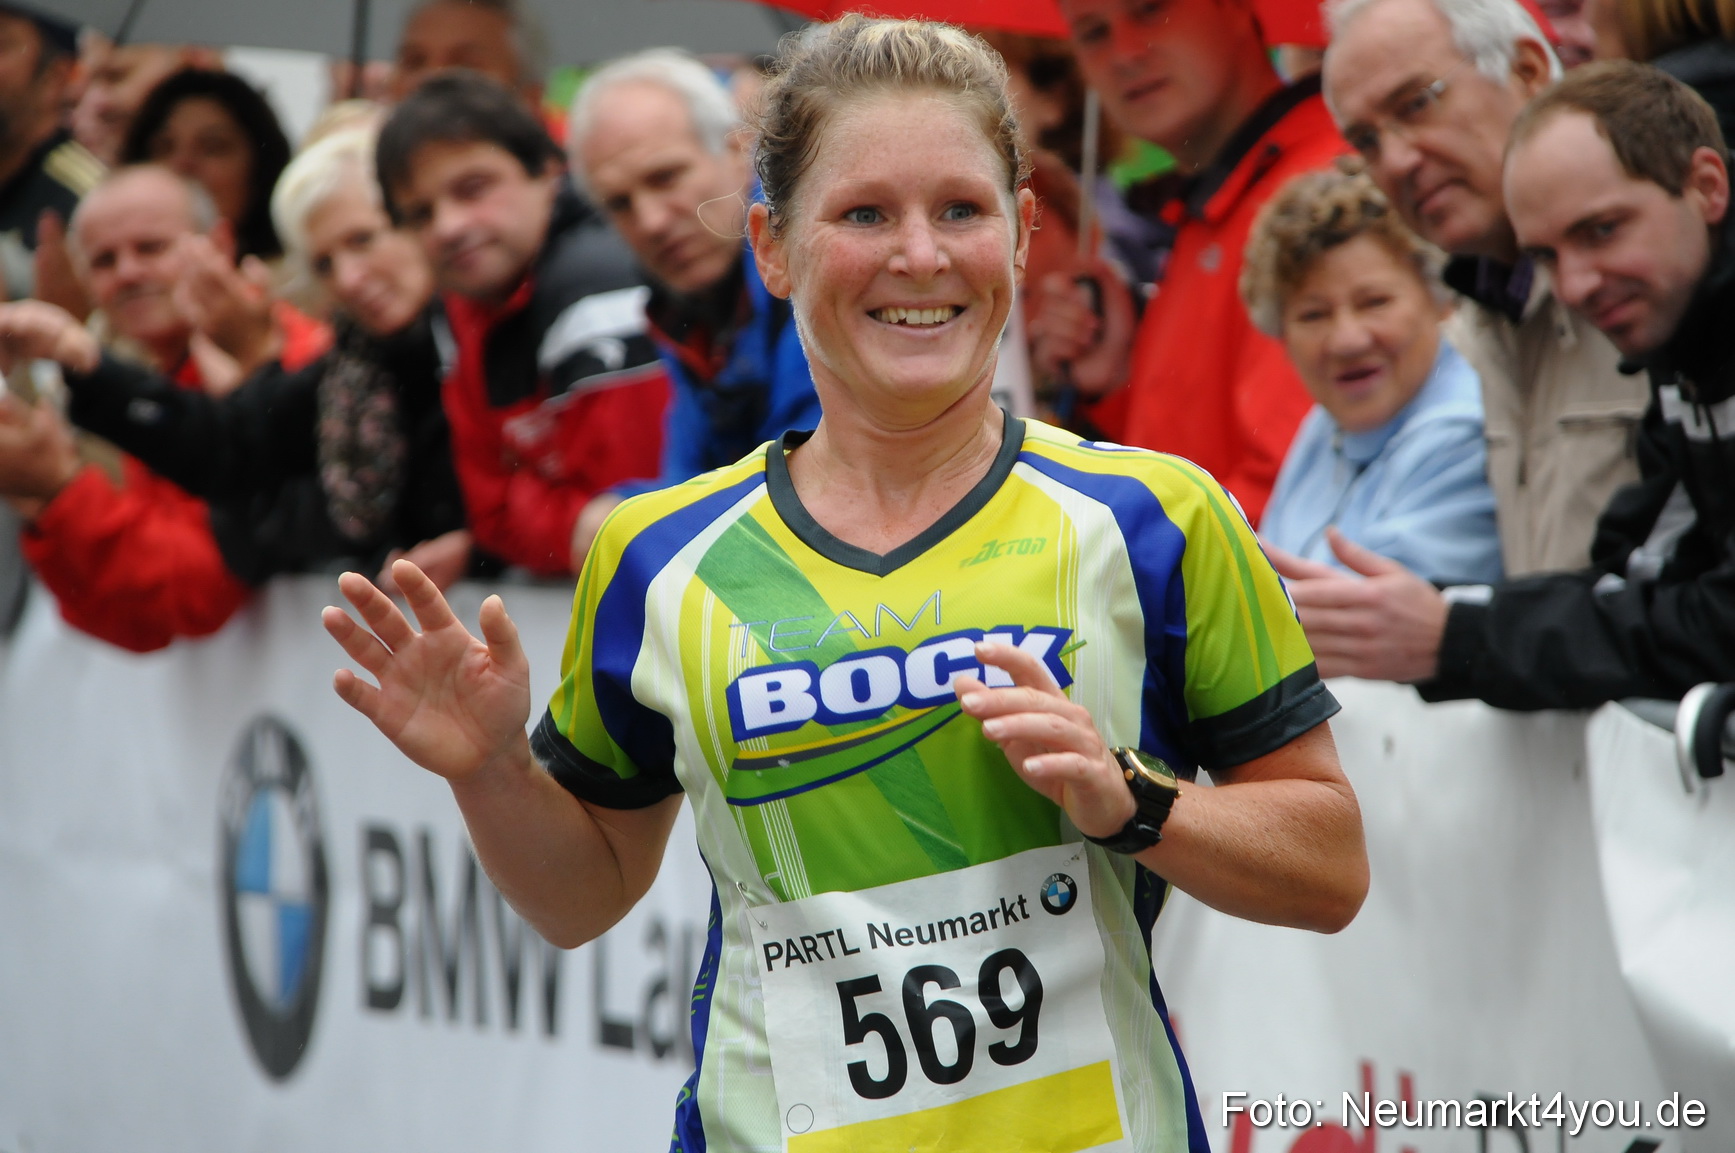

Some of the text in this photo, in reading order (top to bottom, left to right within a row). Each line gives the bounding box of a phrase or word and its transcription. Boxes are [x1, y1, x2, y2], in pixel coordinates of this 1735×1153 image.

[728, 589, 942, 658] TEAM
[728, 626, 1073, 741] BOCK
[361, 823, 564, 1038] BMW
[763, 928, 861, 972] PARTL
[866, 893, 1031, 951] Neumarkt
[836, 947, 1044, 1100] 569
